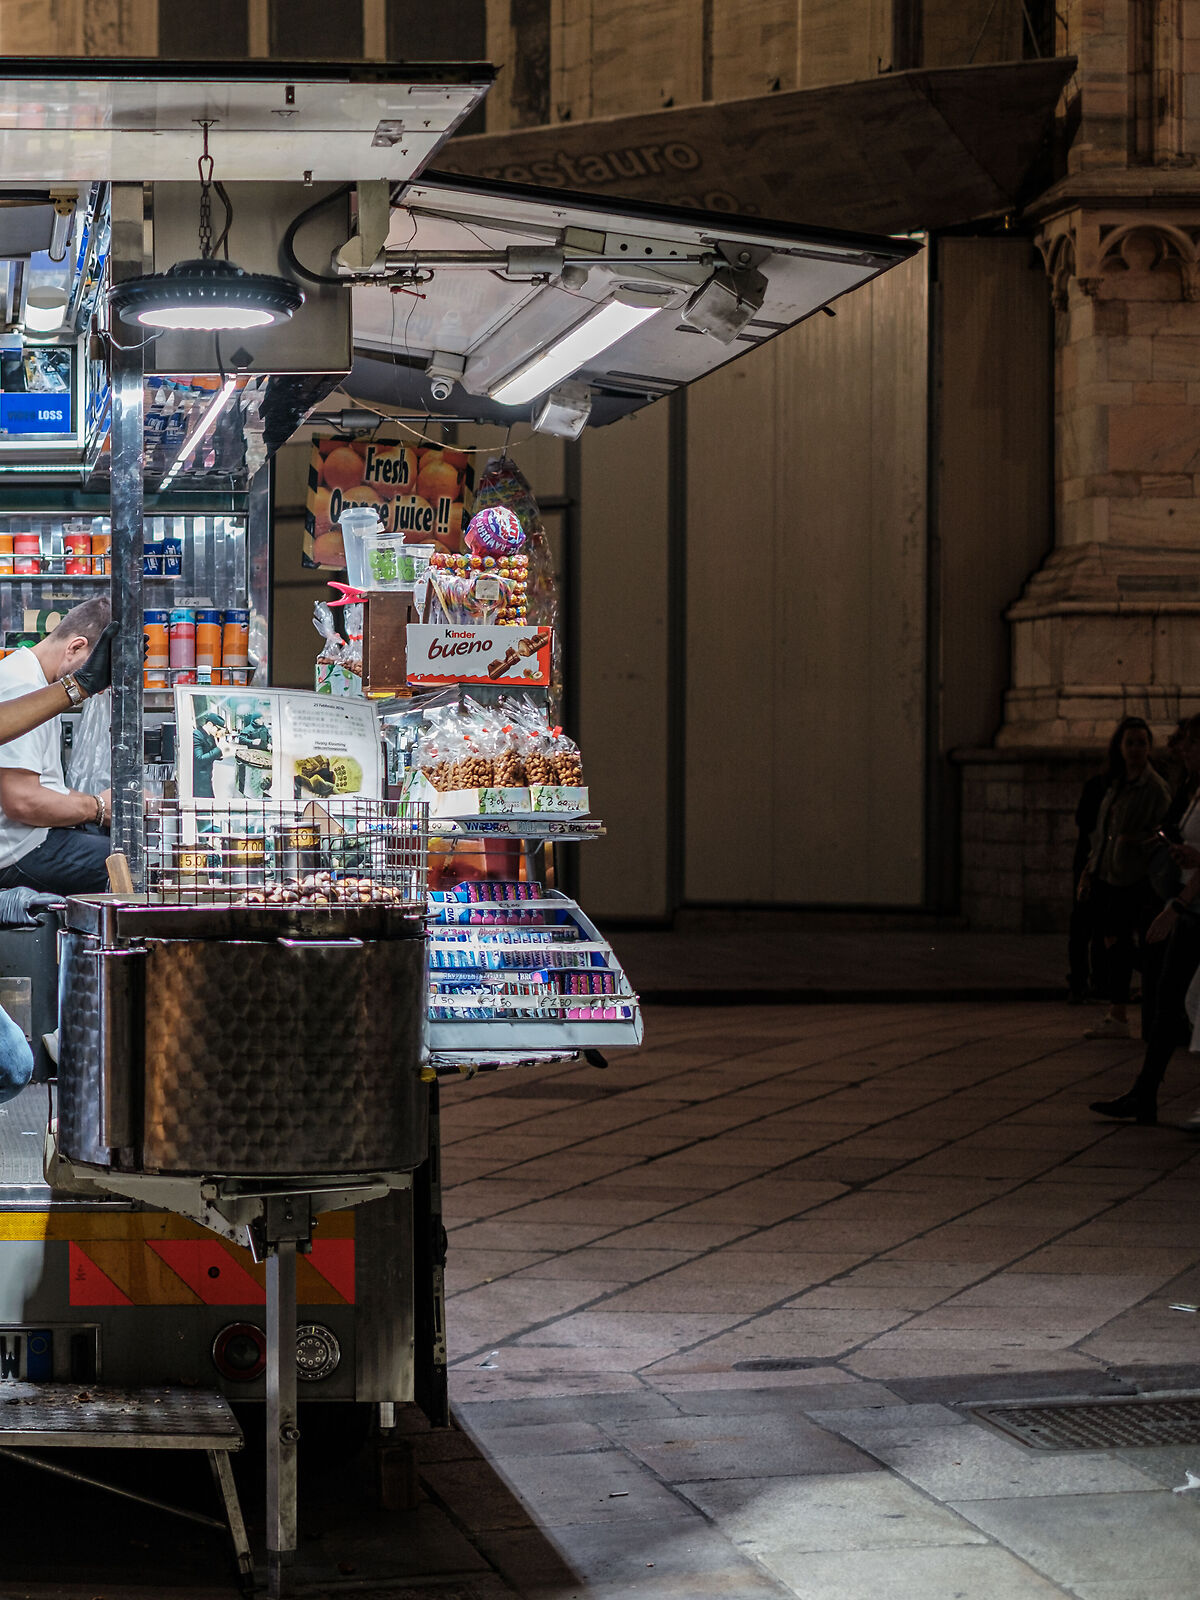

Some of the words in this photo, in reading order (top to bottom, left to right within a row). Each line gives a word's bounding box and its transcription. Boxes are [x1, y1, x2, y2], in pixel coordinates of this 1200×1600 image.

[37, 410, 63, 420] LOSS
[365, 446, 409, 484] Fresh
[393, 495, 434, 532] juice
[437, 497, 450, 533] !!
[445, 629, 476, 639] Kinder
[428, 638, 493, 660] bueno
